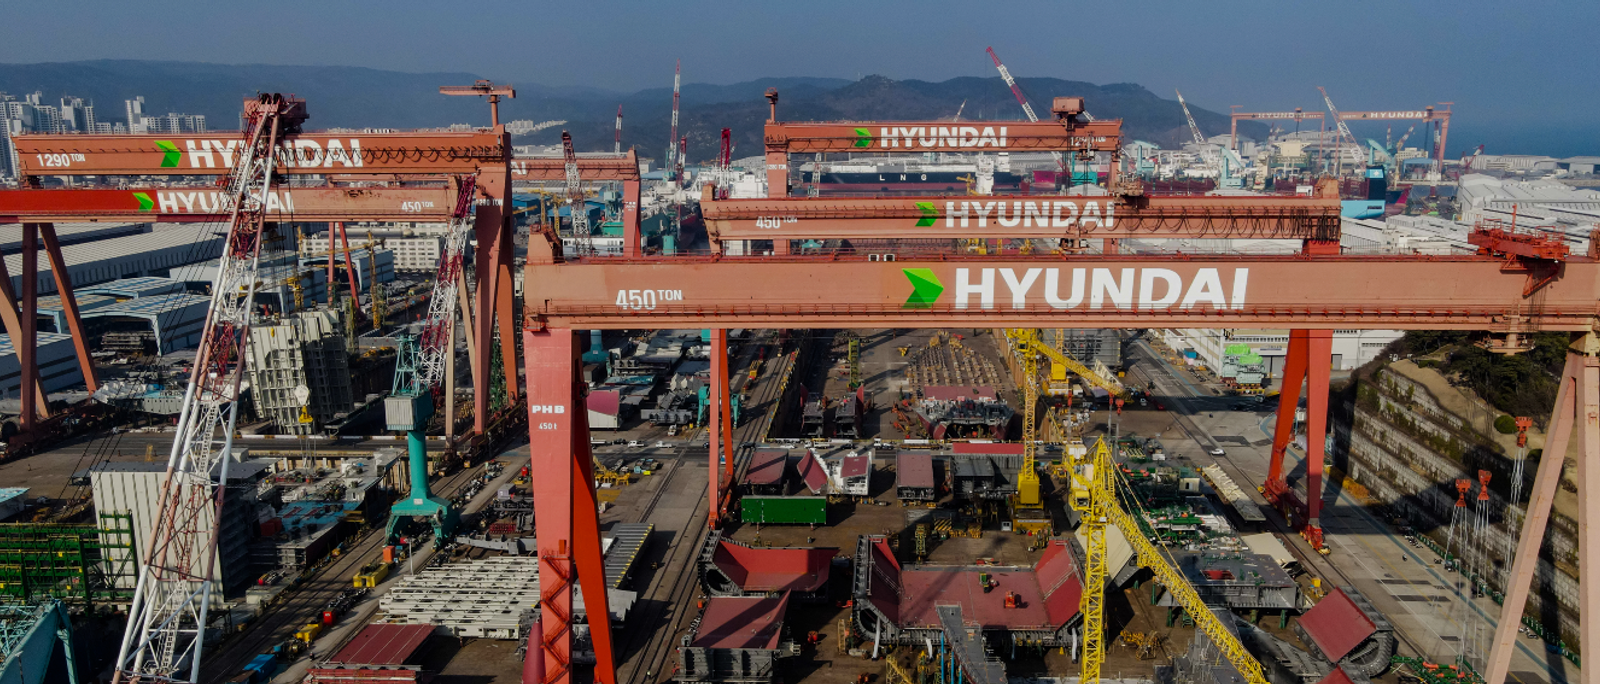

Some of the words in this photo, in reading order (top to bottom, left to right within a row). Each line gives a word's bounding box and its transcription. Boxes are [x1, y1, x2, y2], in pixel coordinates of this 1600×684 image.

[880, 127, 1007, 147] HYUNDAI
[36, 153, 70, 167] 1290
[70, 153, 86, 162] TON
[186, 139, 363, 168] HYNDAI
[157, 192, 294, 214] HYUAI
[401, 201, 422, 213] 450
[756, 215, 780, 229] 450
[945, 201, 1115, 228] HYUNDAI
[955, 267, 1249, 309] HYUNDAI
[615, 289, 656, 311] 450
[656, 289, 683, 301] TON
[531, 405, 565, 414] PHB
